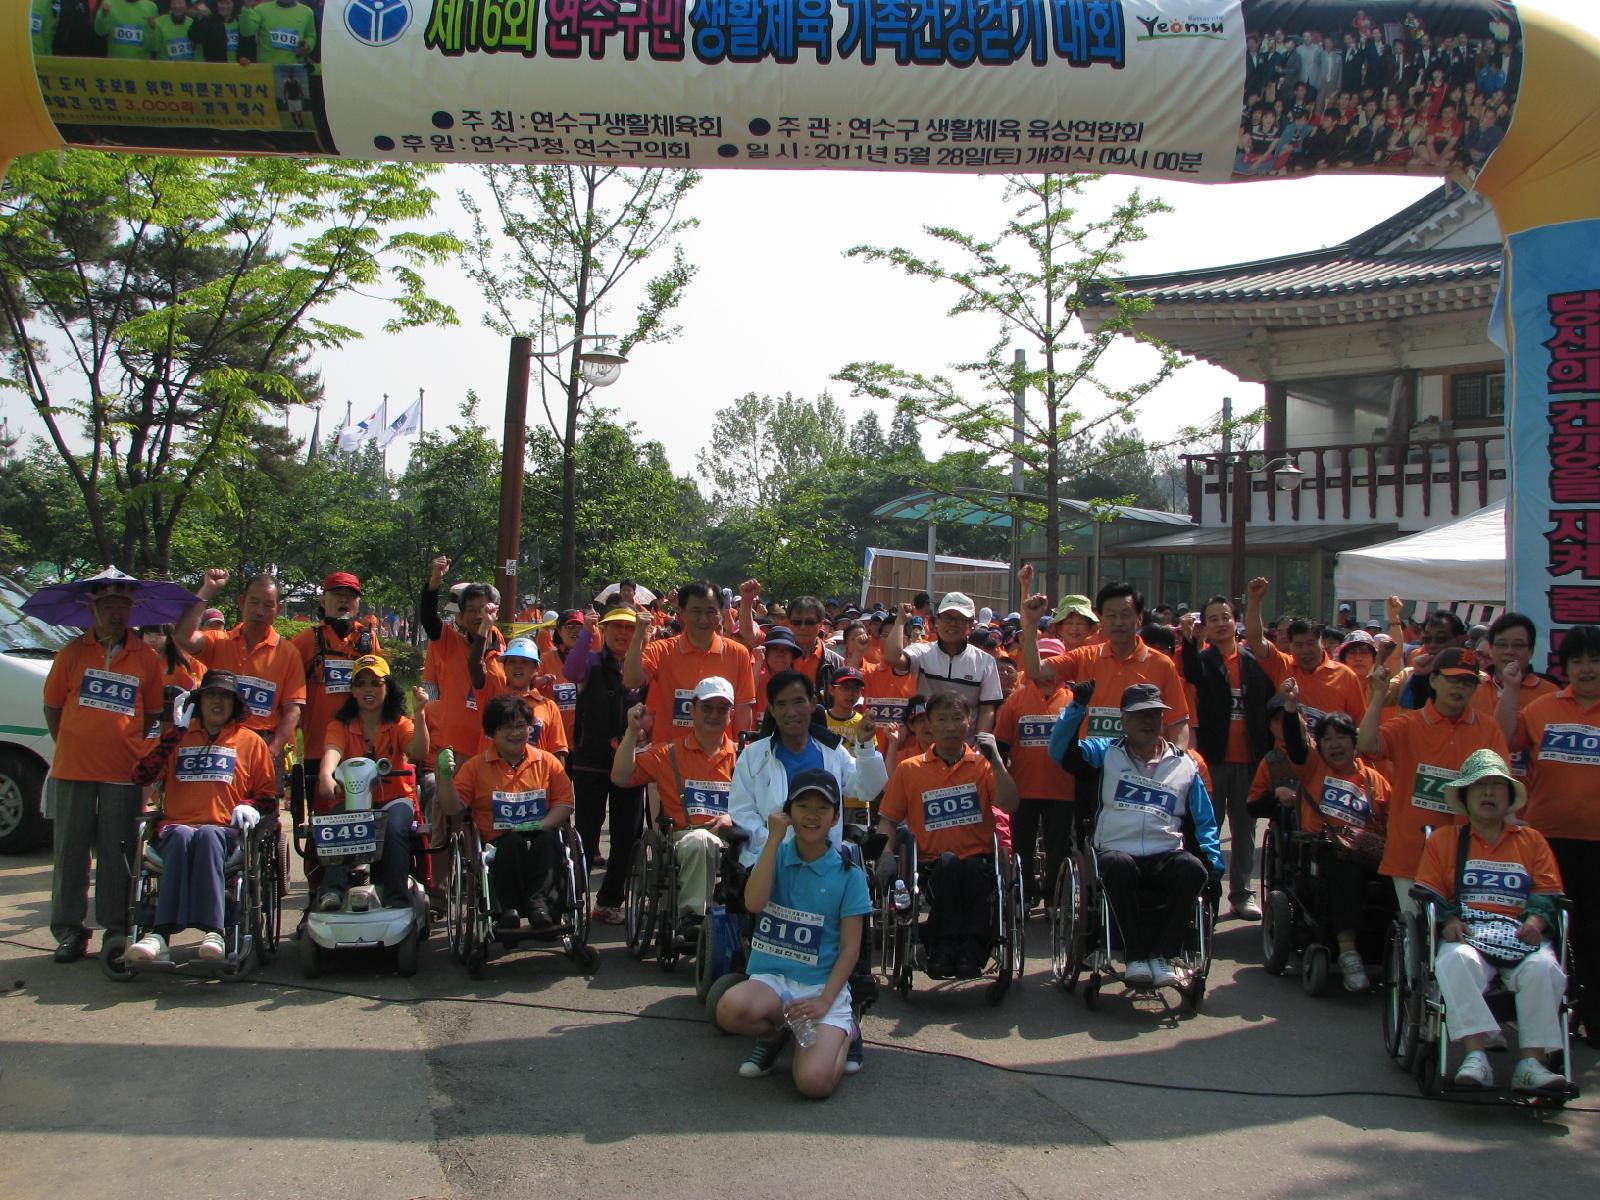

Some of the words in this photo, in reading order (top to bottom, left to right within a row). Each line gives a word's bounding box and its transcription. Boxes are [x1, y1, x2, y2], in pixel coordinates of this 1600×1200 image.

[424, 0, 537, 58] 제16회
[545, 0, 686, 61] 연수구민
[689, 0, 833, 65] 생활체육
[837, 0, 1048, 68] 가족건강걷기
[1051, 0, 1126, 69] 대회
[1136, 15, 1224, 38] Yeonsu
[815, 143, 888, 164] 2011년
[894, 147, 930, 165] 5월
[1153, 152, 1203, 173] 00분
[330, 668, 352, 681] 64
[89, 680, 133, 700] 646
[242, 687, 268, 703] 16
[559, 690, 577, 701] 62
[1023, 722, 1054, 734] 61
[1091, 719, 1123, 731] 100
[1549, 732, 1598, 749] 710
[183, 756, 229, 770] 634
[693, 791, 729, 805] 61
[1124, 784, 1168, 806] 711
[1324, 788, 1363, 811] 640
[501, 803, 540, 818] 644
[928, 795, 974, 816] 605
[321, 824, 368, 841] 649
[1462, 872, 1521, 889] 620
[759, 916, 813, 944] 610
